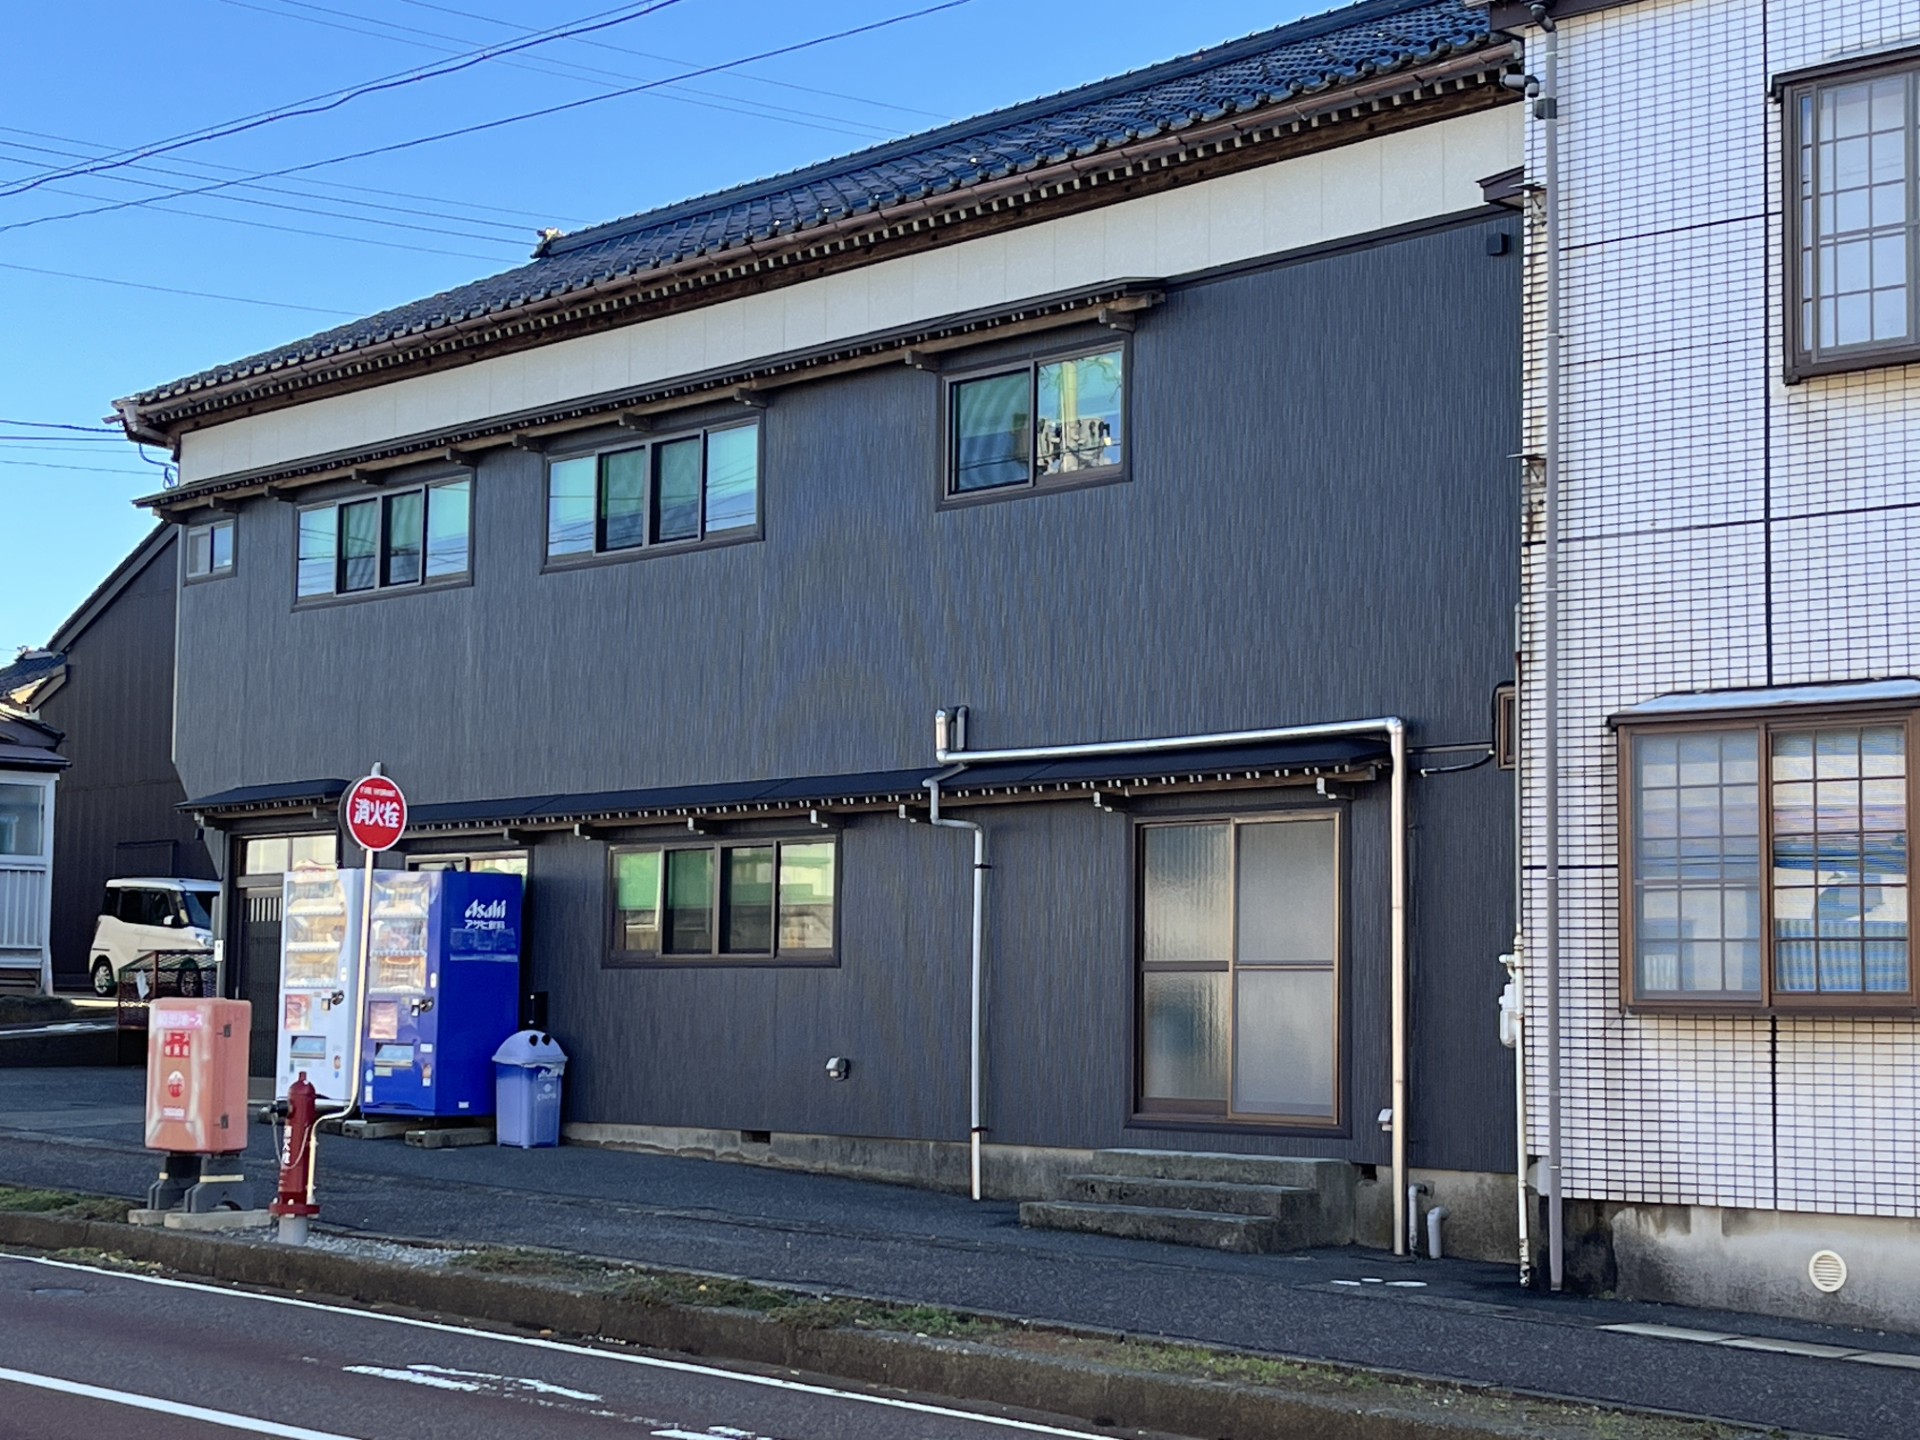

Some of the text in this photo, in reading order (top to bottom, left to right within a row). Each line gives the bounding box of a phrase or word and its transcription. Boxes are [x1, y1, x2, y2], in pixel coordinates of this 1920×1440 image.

[354, 797, 400, 828] 消火栓
[465, 899, 506, 918] Asahi
